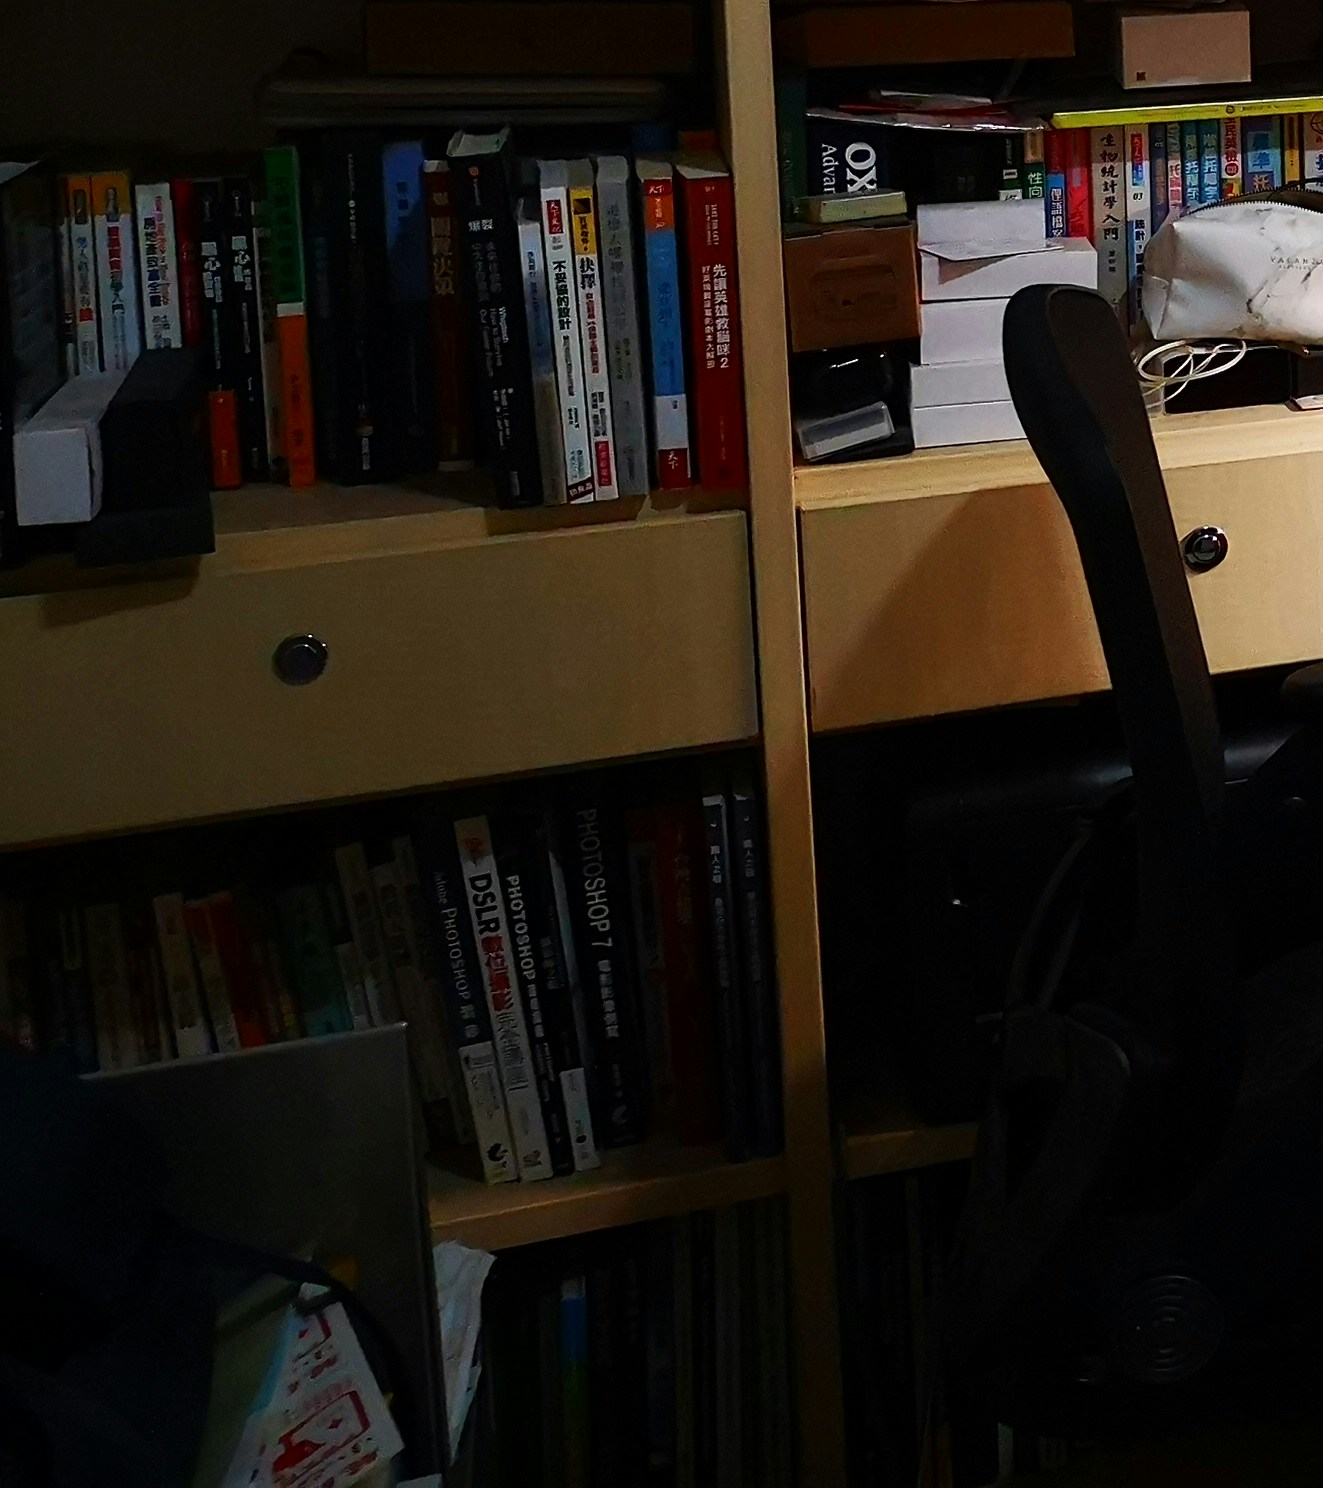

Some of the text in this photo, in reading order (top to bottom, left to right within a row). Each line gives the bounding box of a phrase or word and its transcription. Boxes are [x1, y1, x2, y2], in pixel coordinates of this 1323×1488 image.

[1100, 132, 1120, 241] 生物統計學入門
[1133, 192, 1143, 201] 03
[468, 873, 501, 935] DSLR
